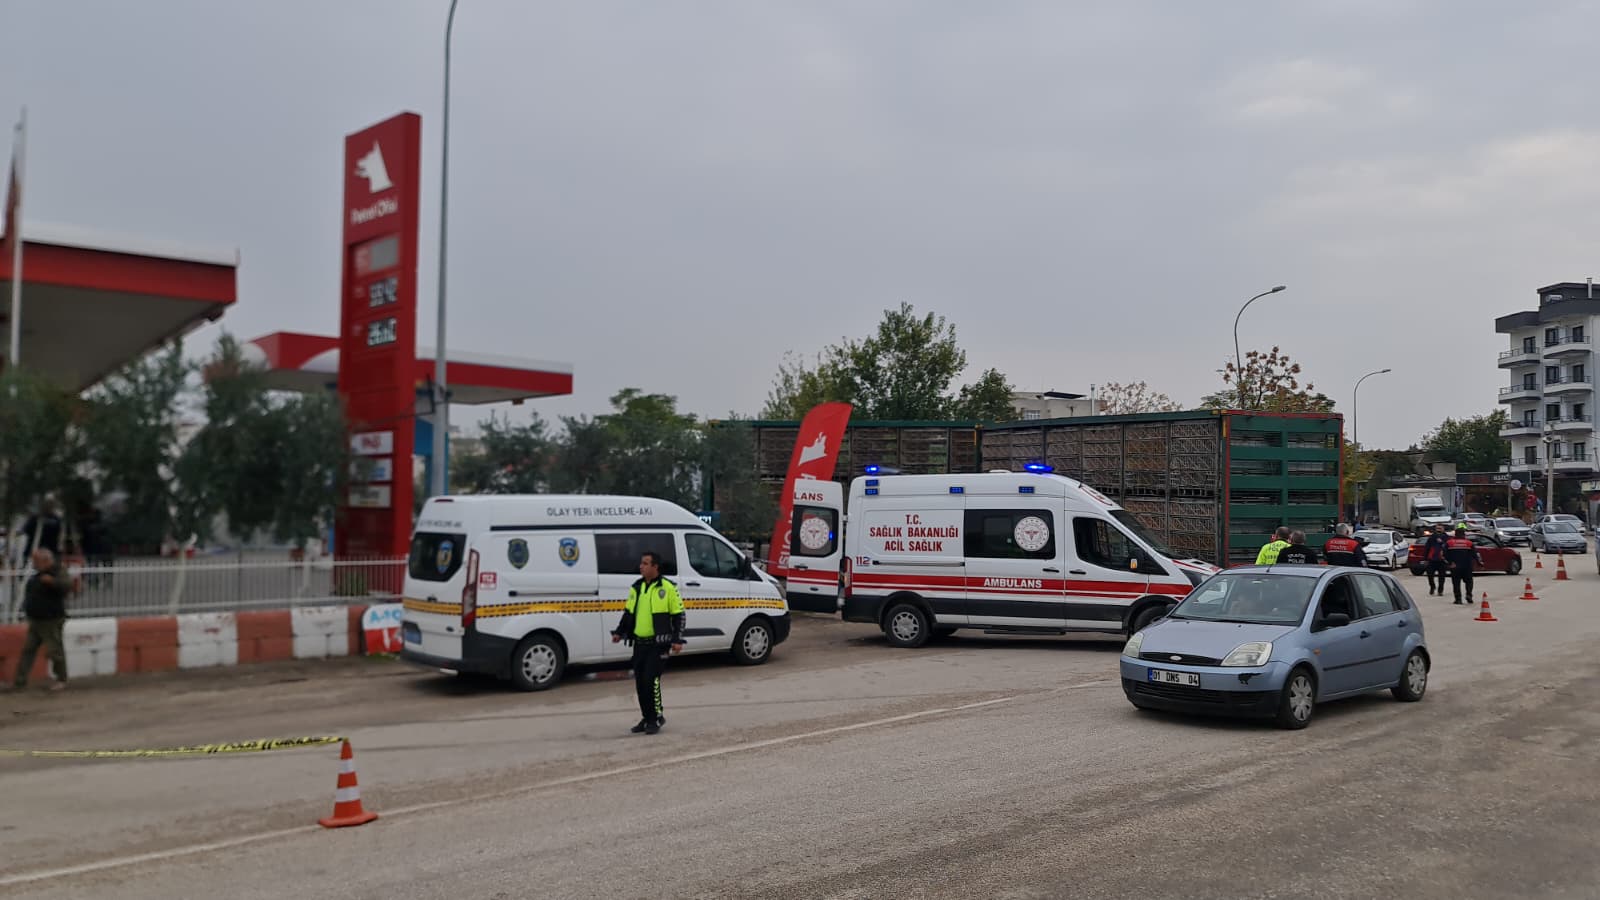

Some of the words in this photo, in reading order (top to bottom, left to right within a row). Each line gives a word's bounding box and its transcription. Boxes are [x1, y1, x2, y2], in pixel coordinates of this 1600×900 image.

[794, 492, 824, 502] LANS
[546, 507, 569, 517] OLAY
[905, 514, 922, 525] T.C.
[869, 525, 902, 537] SAĞLIK
[907, 525, 959, 538] BAKANLIĞI
[908, 539, 943, 551] SAĞLIK
[855, 556, 870, 565] 112
[984, 577, 1042, 589] AMBULANS
[1188, 675, 1198, 684] 04
